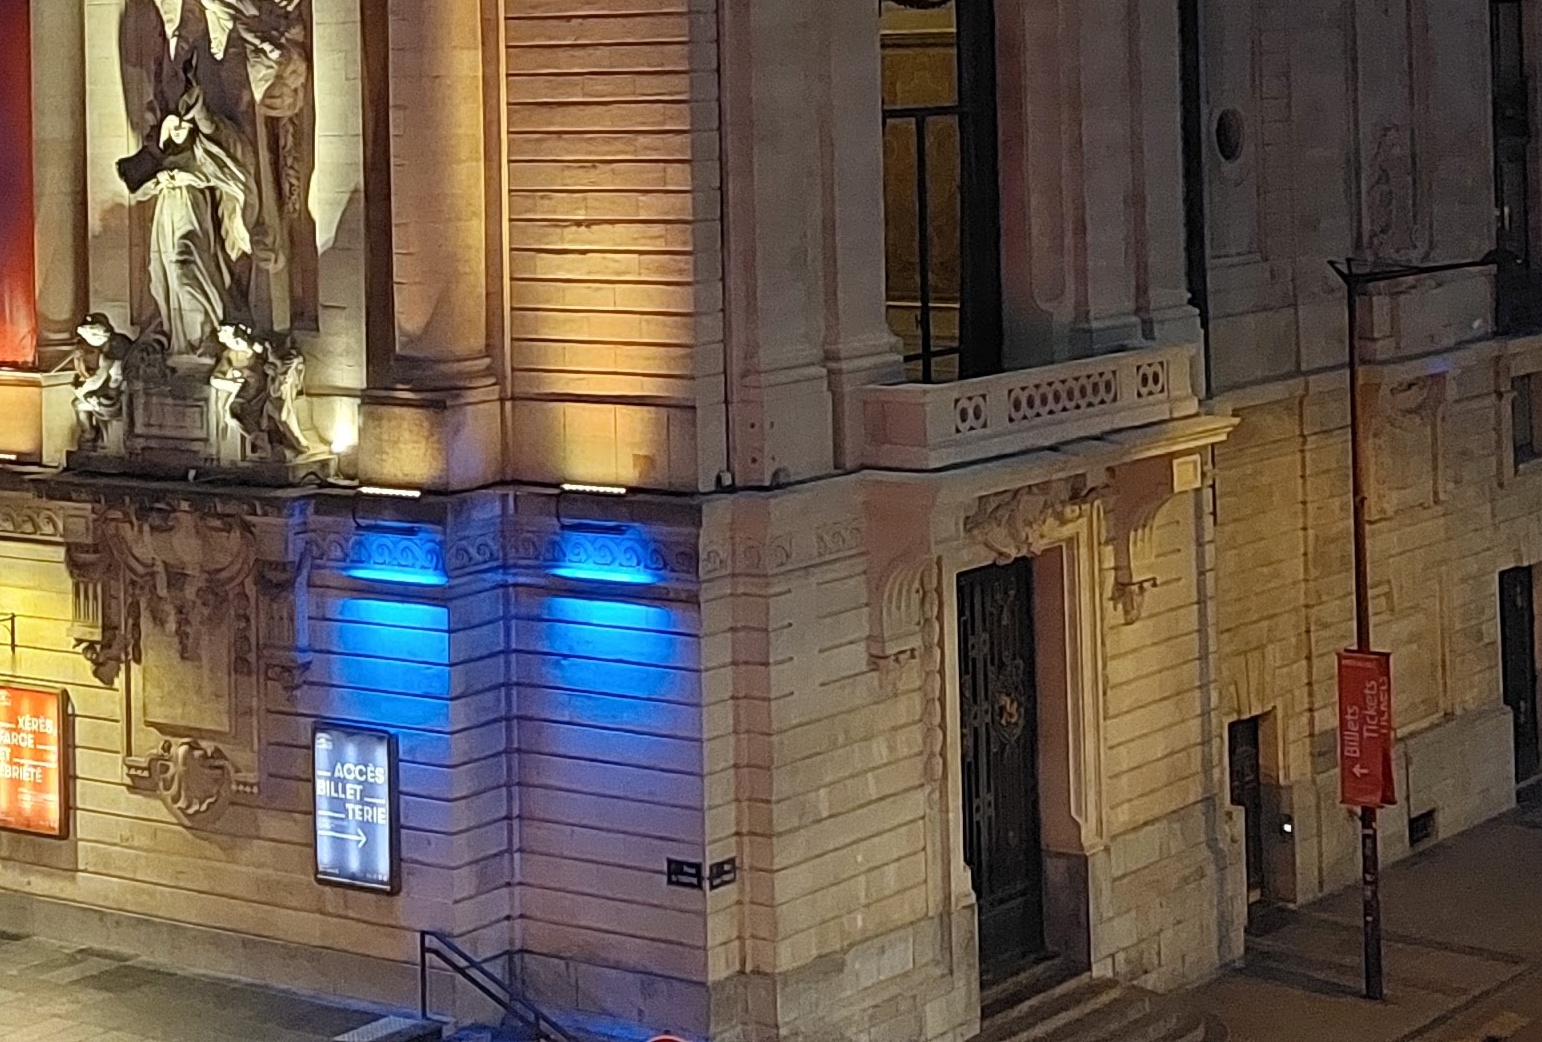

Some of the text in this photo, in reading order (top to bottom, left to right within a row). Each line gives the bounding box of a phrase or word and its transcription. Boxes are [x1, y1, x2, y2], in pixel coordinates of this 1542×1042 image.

[1363, 680, 1379, 739] Tickets
[0, 729, 34, 749] FARCE
[1343, 705, 1360, 758] Billets
[334, 762, 385, 784] ACCÈS
[317, 779, 363, 801] BILLET
[345, 803, 387, 825] TERIE
